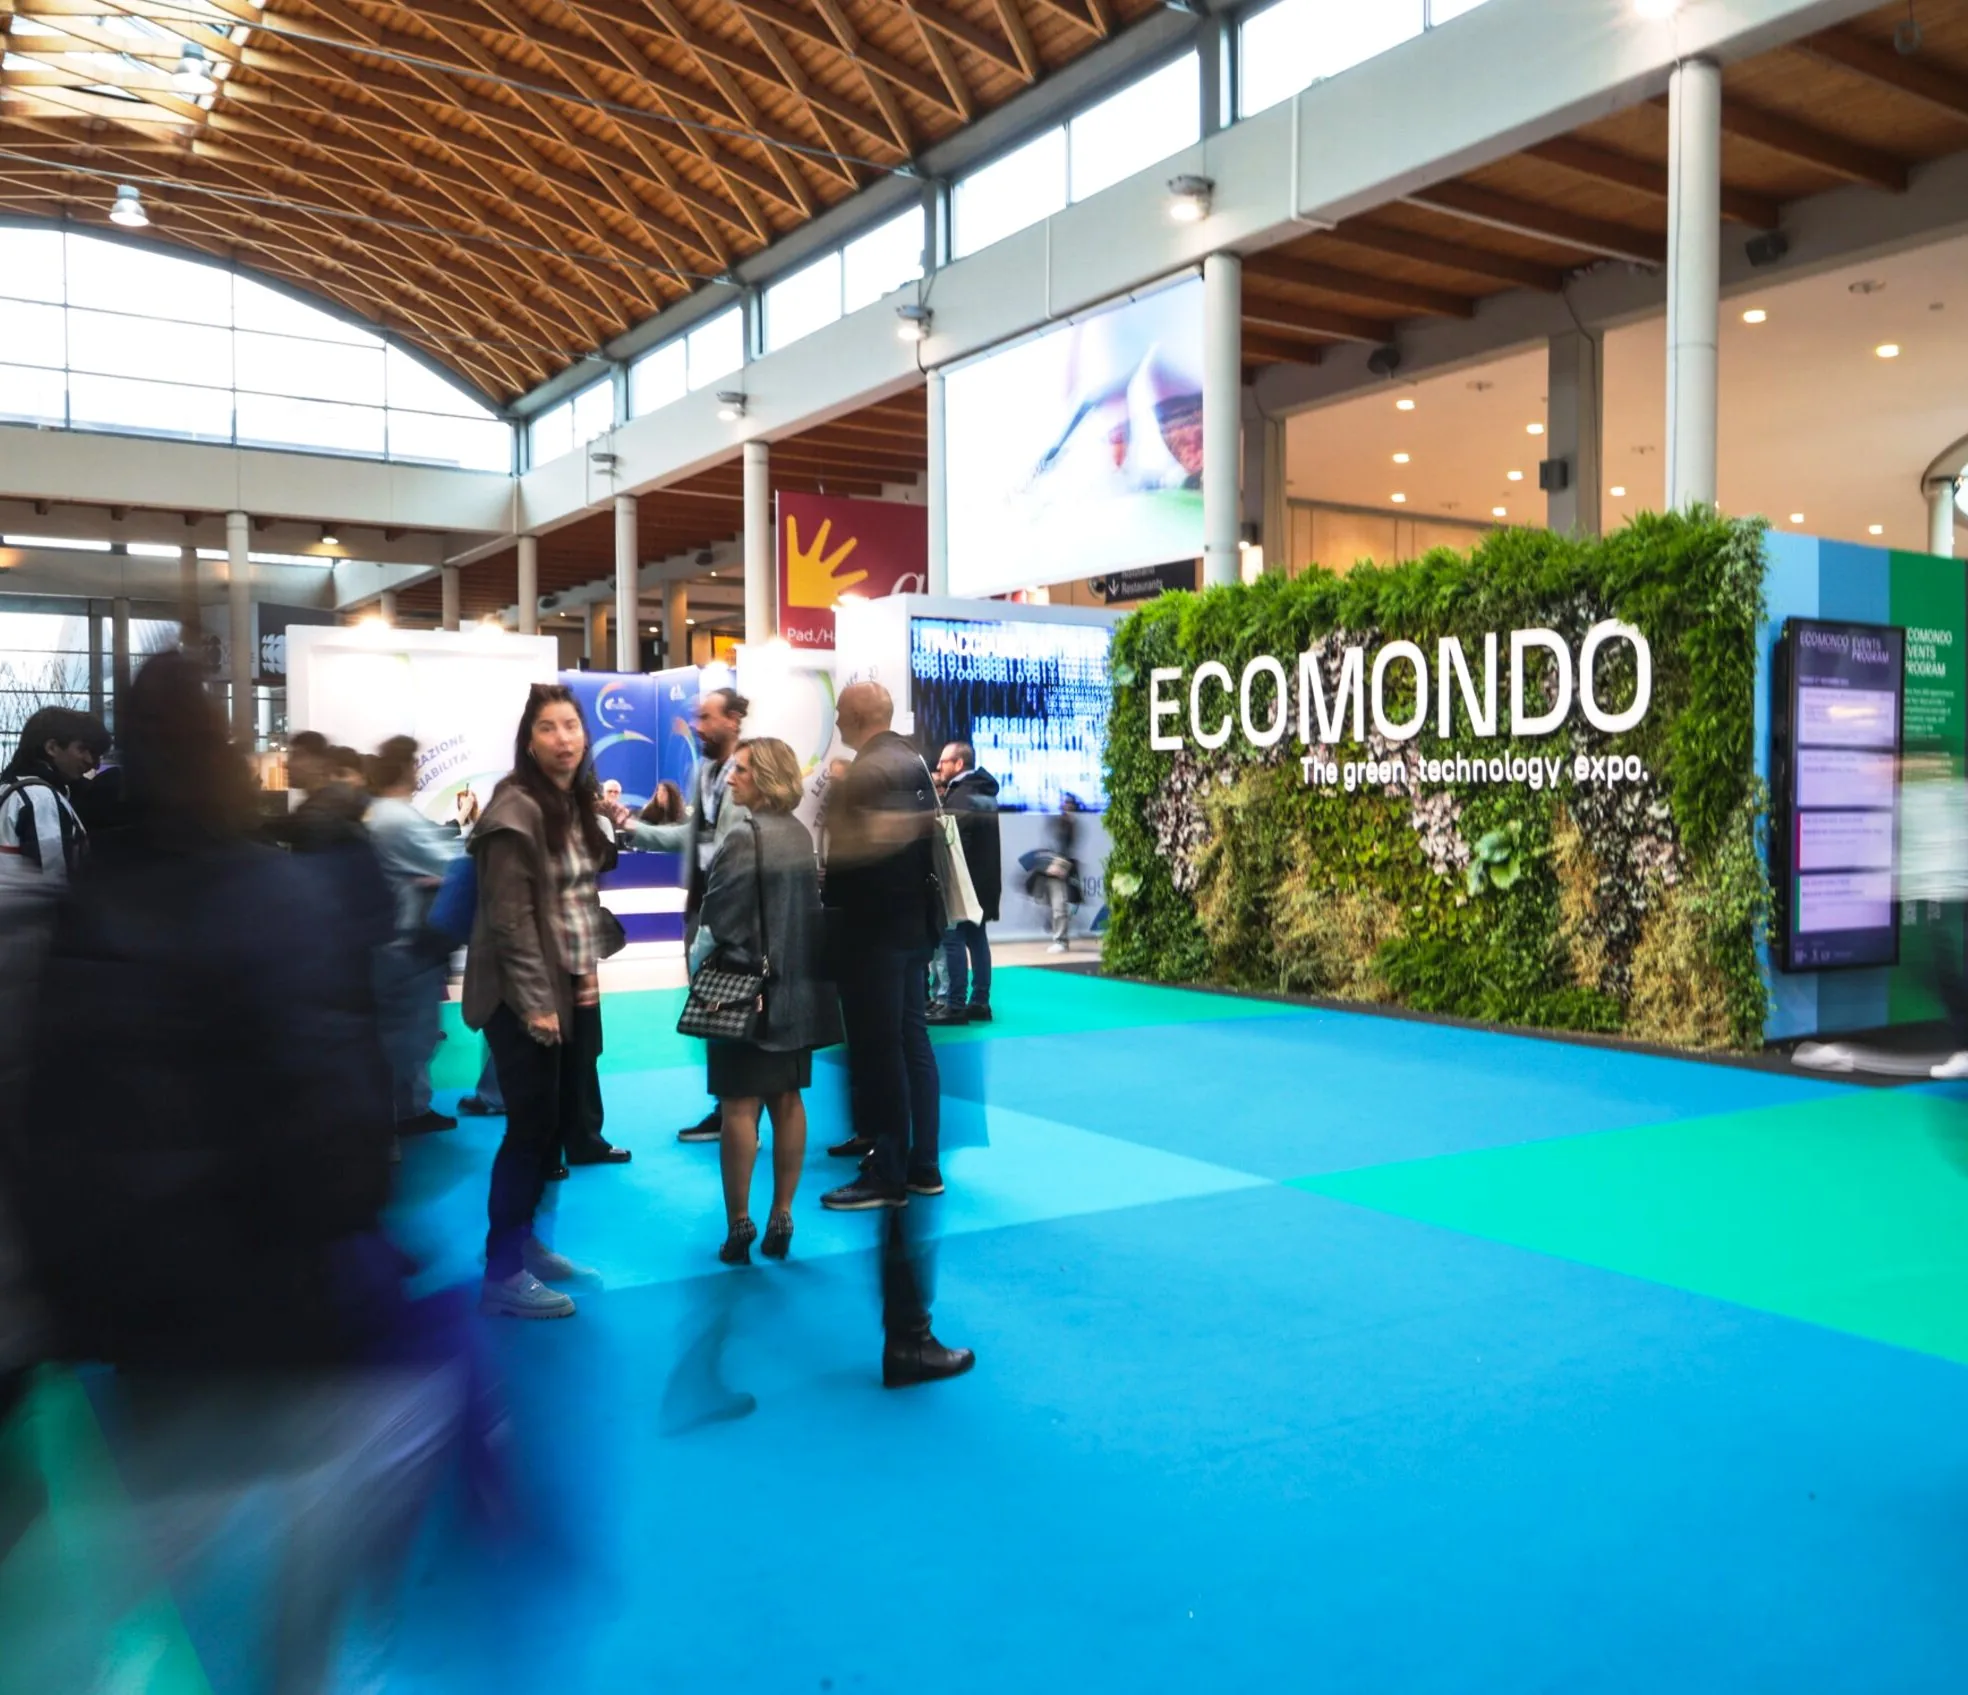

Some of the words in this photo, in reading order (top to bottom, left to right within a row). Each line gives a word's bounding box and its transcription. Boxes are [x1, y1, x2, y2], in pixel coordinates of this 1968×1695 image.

[1121, 578, 1163, 595] Restaurants
[787, 627, 835, 644] Pad./H
[1800, 631, 1849, 649] ECOMONDO
[1852, 635, 1881, 650] EVENTS
[1906, 627, 1952, 646] COMONDO
[1906, 644, 1936, 660] VENTS
[1150, 618, 1652, 751] ECOMONDO
[1300, 756, 1338, 786] The
[1344, 760, 1406, 792] green
[1419, 750, 1561, 790] technology
[1574, 754, 1648, 789] expo.
